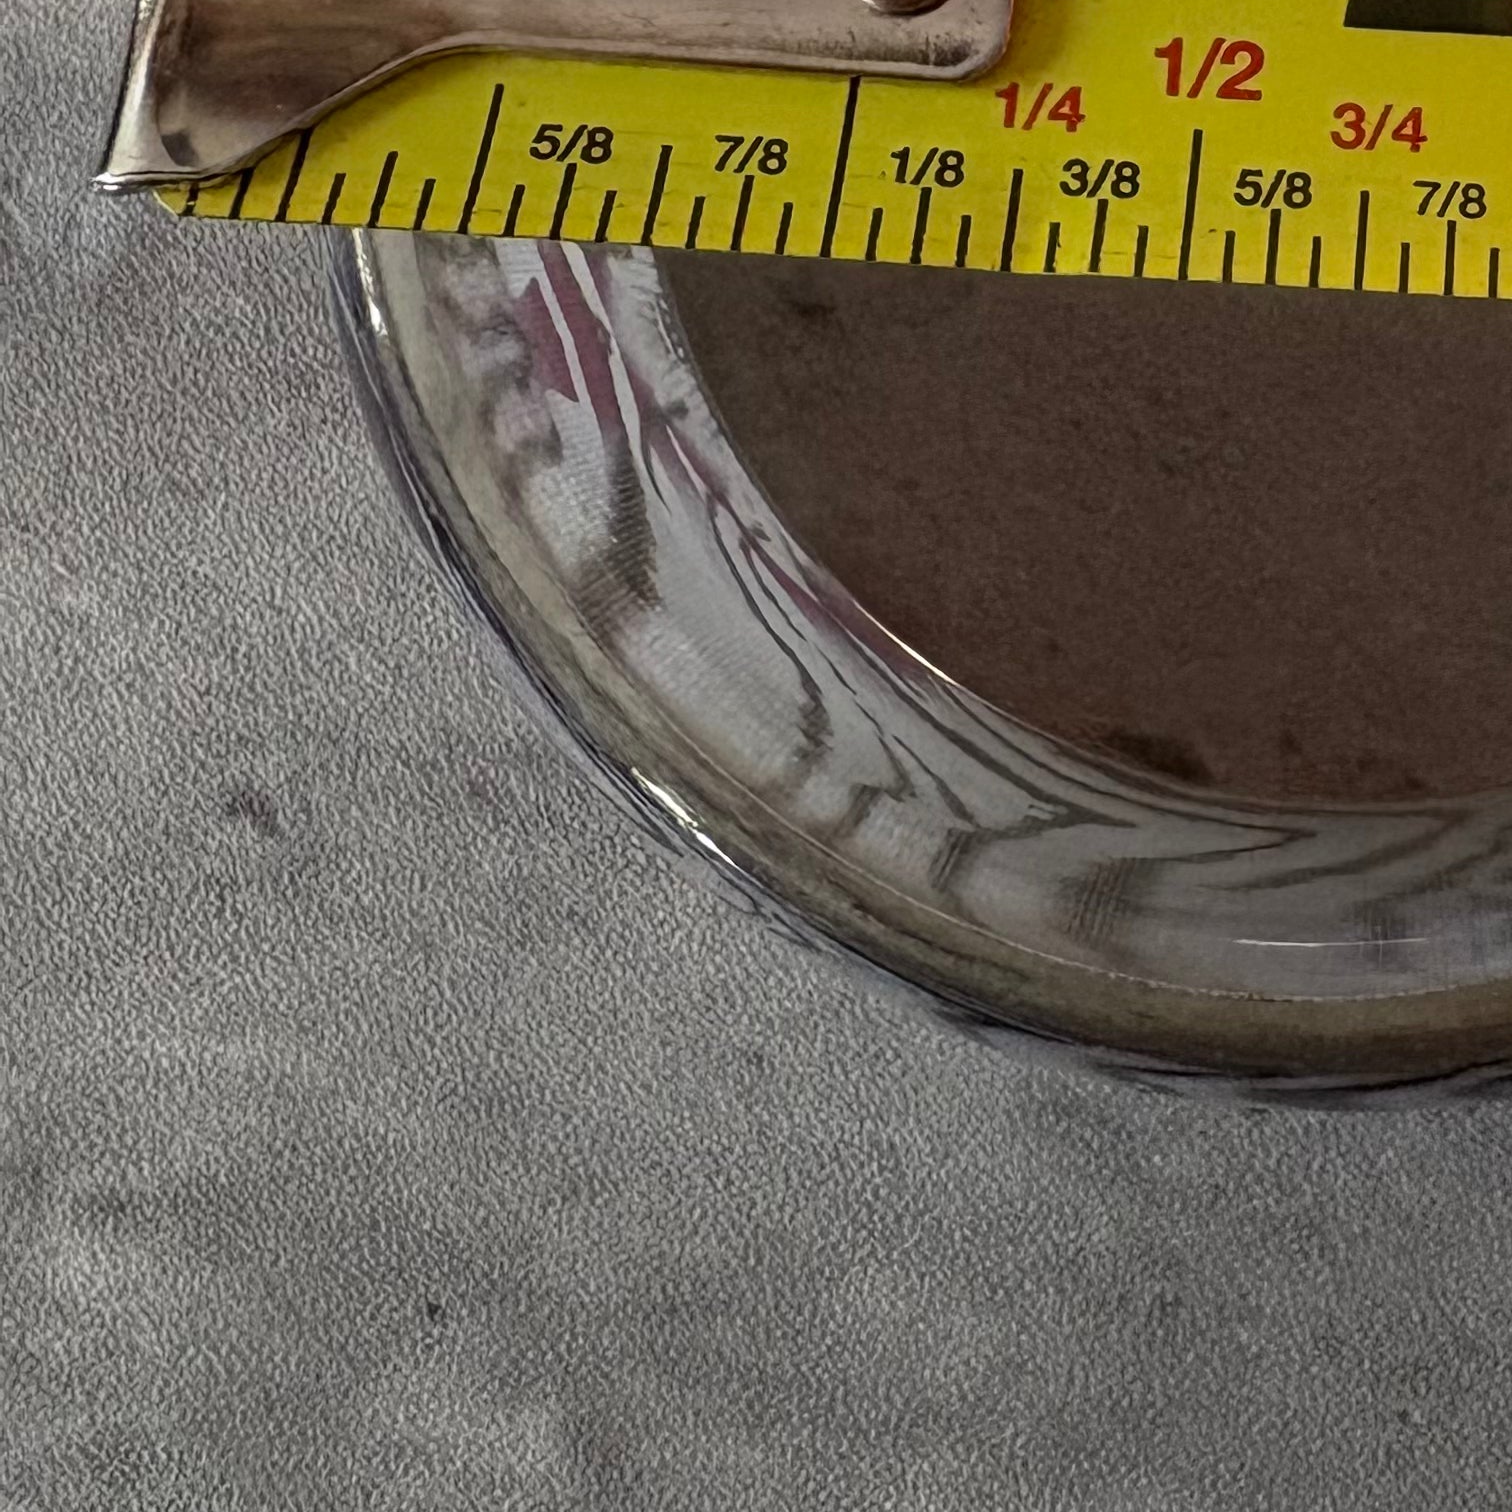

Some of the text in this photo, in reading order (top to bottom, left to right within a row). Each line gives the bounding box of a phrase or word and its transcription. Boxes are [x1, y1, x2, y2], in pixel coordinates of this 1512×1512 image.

[1155, 38, 1265, 101] 1/2
[996, 83, 1085, 132] 1/4
[530, 124, 613, 164] 5/8
[1331, 104, 1428, 152] 3/4
[715, 134, 789, 176] 7/8
[890, 148, 964, 188] 1/8
[1059, 159, 1140, 199] 3/8
[1234, 169, 1313, 209] 5/8
[1412, 181, 1488, 219] 7/8
